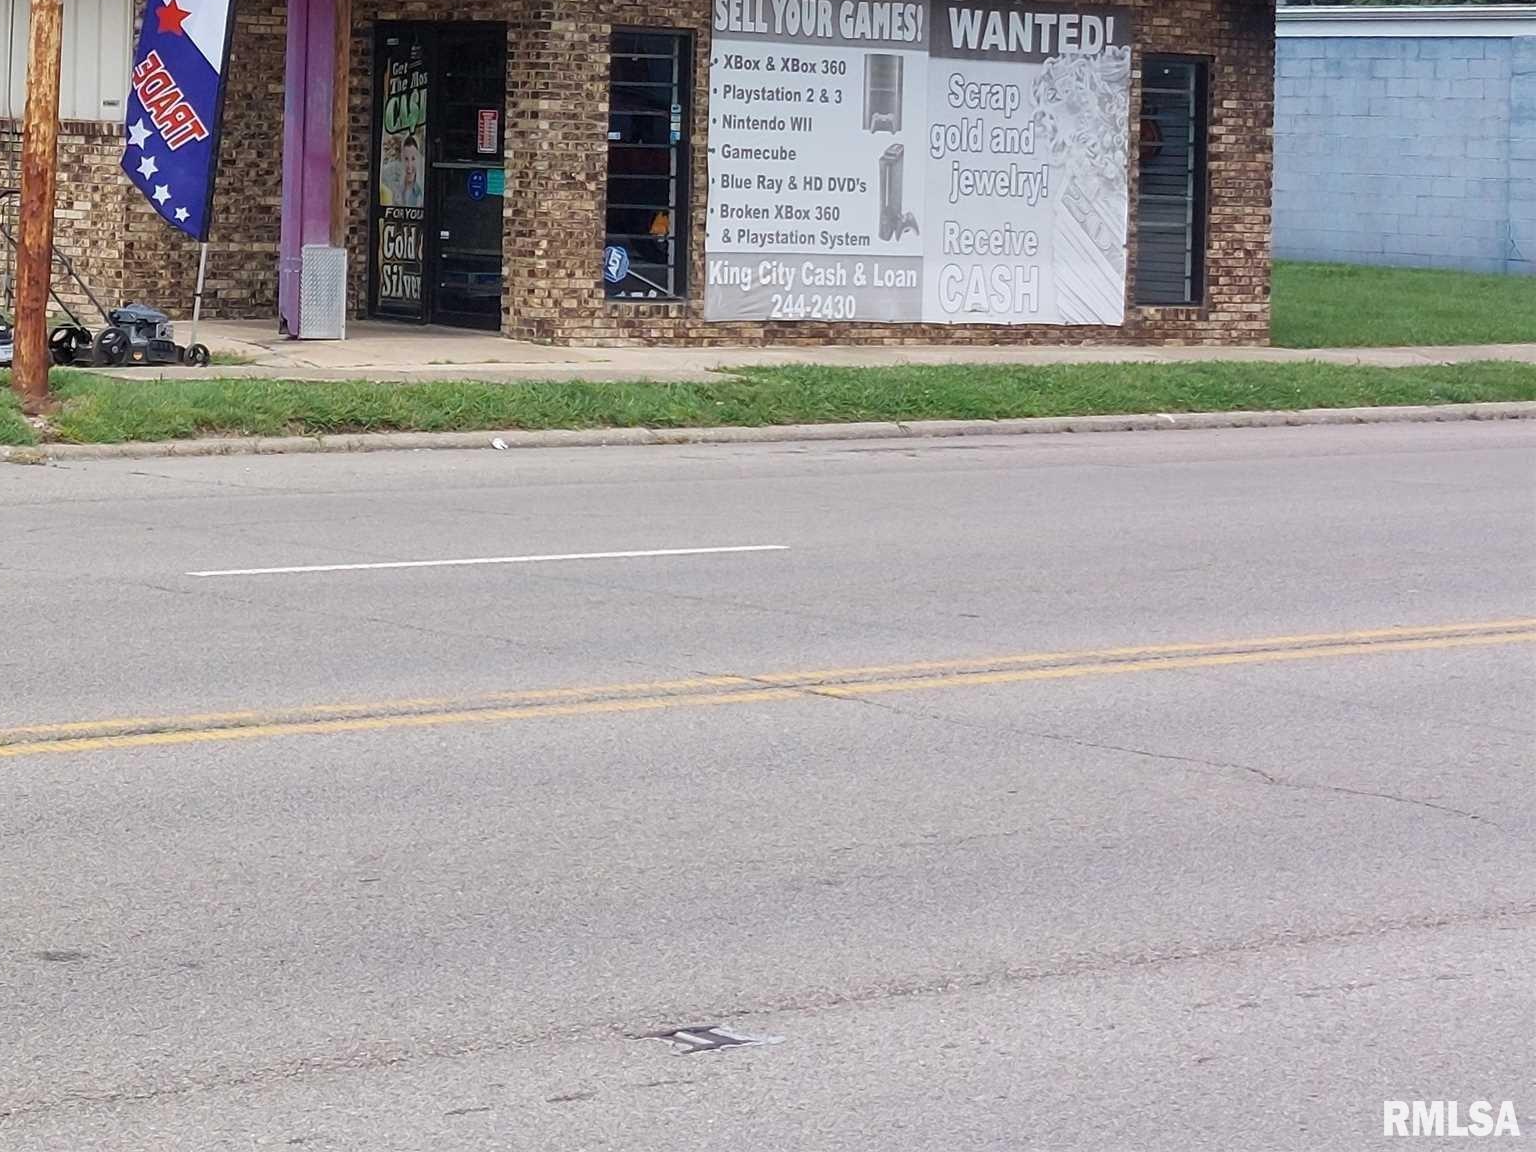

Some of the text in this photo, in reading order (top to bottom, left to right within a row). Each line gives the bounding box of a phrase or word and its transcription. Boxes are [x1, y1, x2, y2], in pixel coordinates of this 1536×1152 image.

[839, 0, 924, 42] GAMES!
[948, 7, 1114, 56] WANTED!
[723, 54, 846, 75] XBox & XBox 360
[410, 71, 428, 89] Mos
[722, 84, 842, 104] Playstation 2 & 3
[947, 72, 1020, 118] Scrap
[722, 114, 812, 132] Nintendo WII
[929, 118, 1035, 158] gold and
[721, 144, 797, 161] Gamecube
[720, 173, 867, 193] Blue Ray & HD DVD's
[949, 160, 1049, 206] jewelry!
[720, 203, 840, 221] Broken XBox 360
[384, 225, 416, 260] Gold
[721, 229, 870, 249] & Playstation System
[944, 220, 1039, 257] Receive
[709, 260, 917, 291] King City Cash & Loan
[938, 263, 1040, 314] CASH
[770, 294, 857, 319] 244-2430
